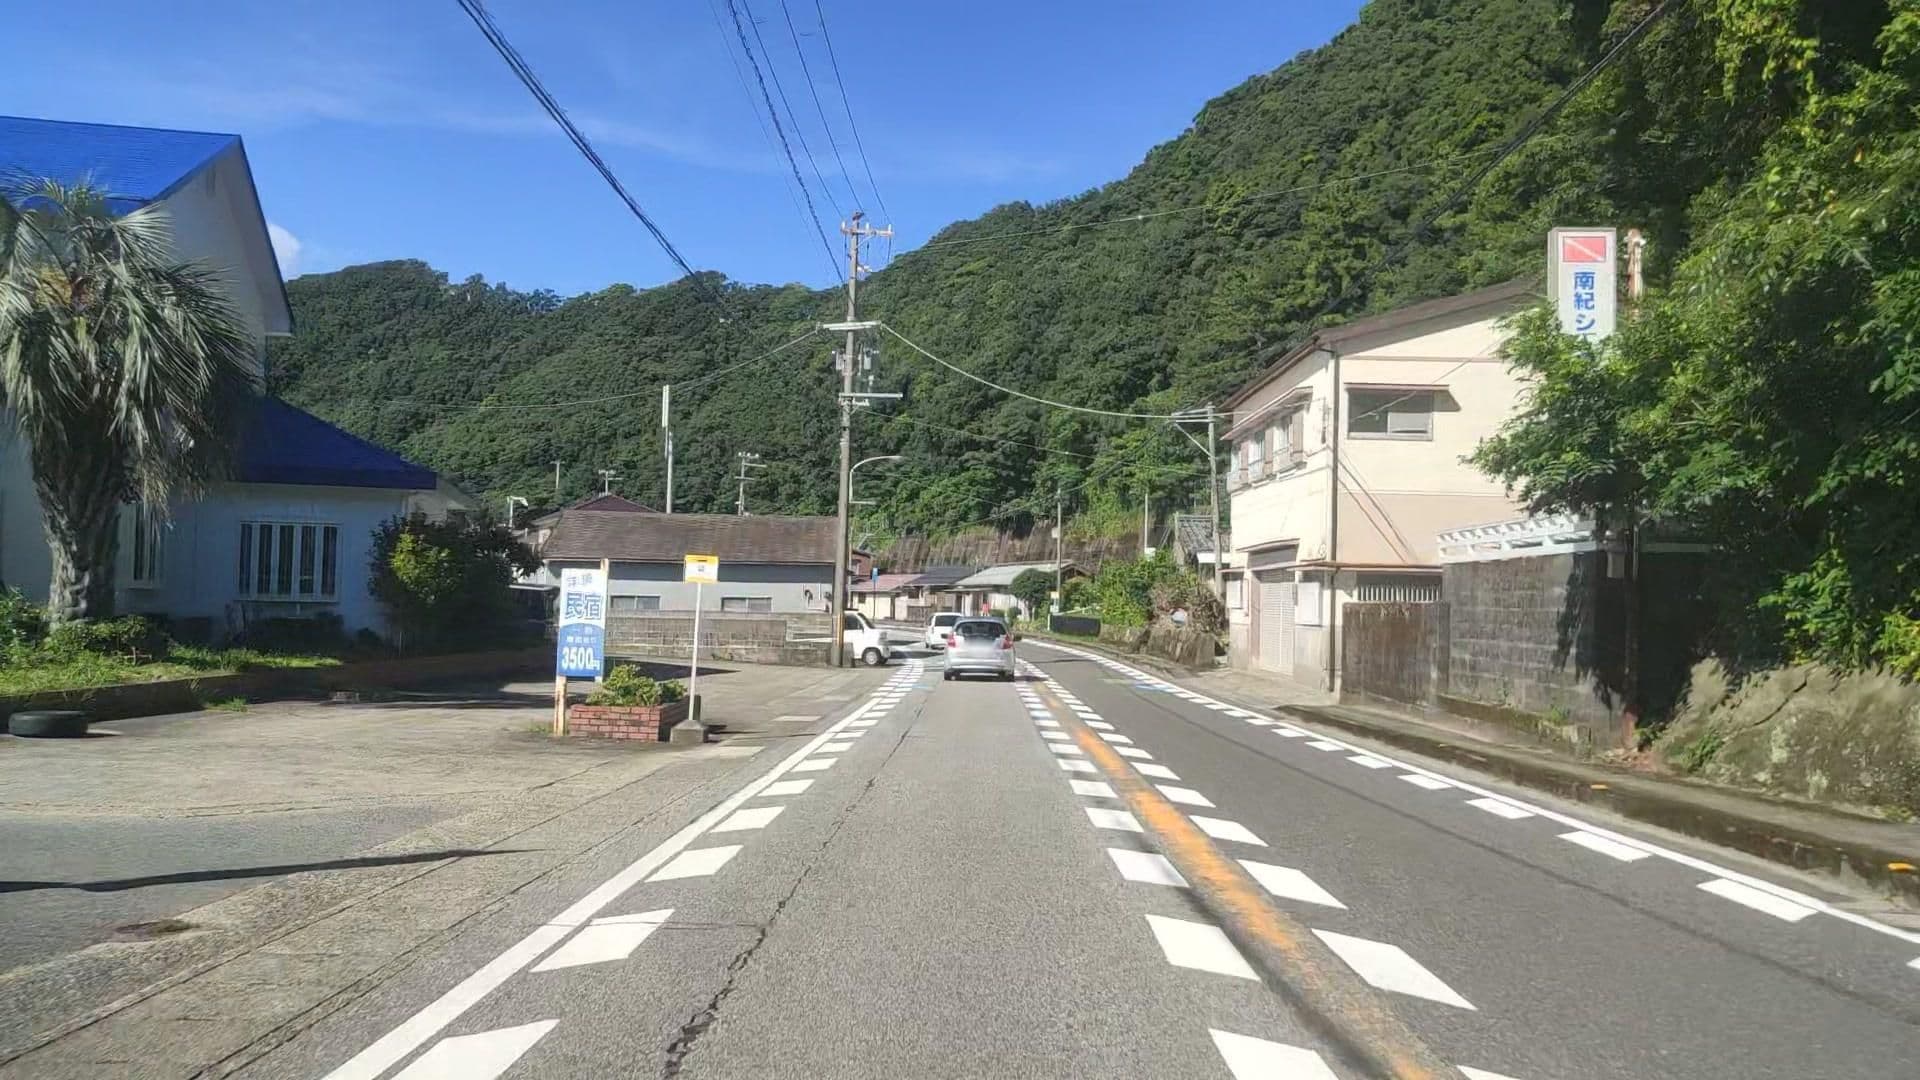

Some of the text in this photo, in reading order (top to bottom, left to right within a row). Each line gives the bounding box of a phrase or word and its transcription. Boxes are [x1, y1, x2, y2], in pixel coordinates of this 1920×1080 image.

[1573, 271, 1597, 341] 南紀シ
[565, 591, 602, 620] 民宿
